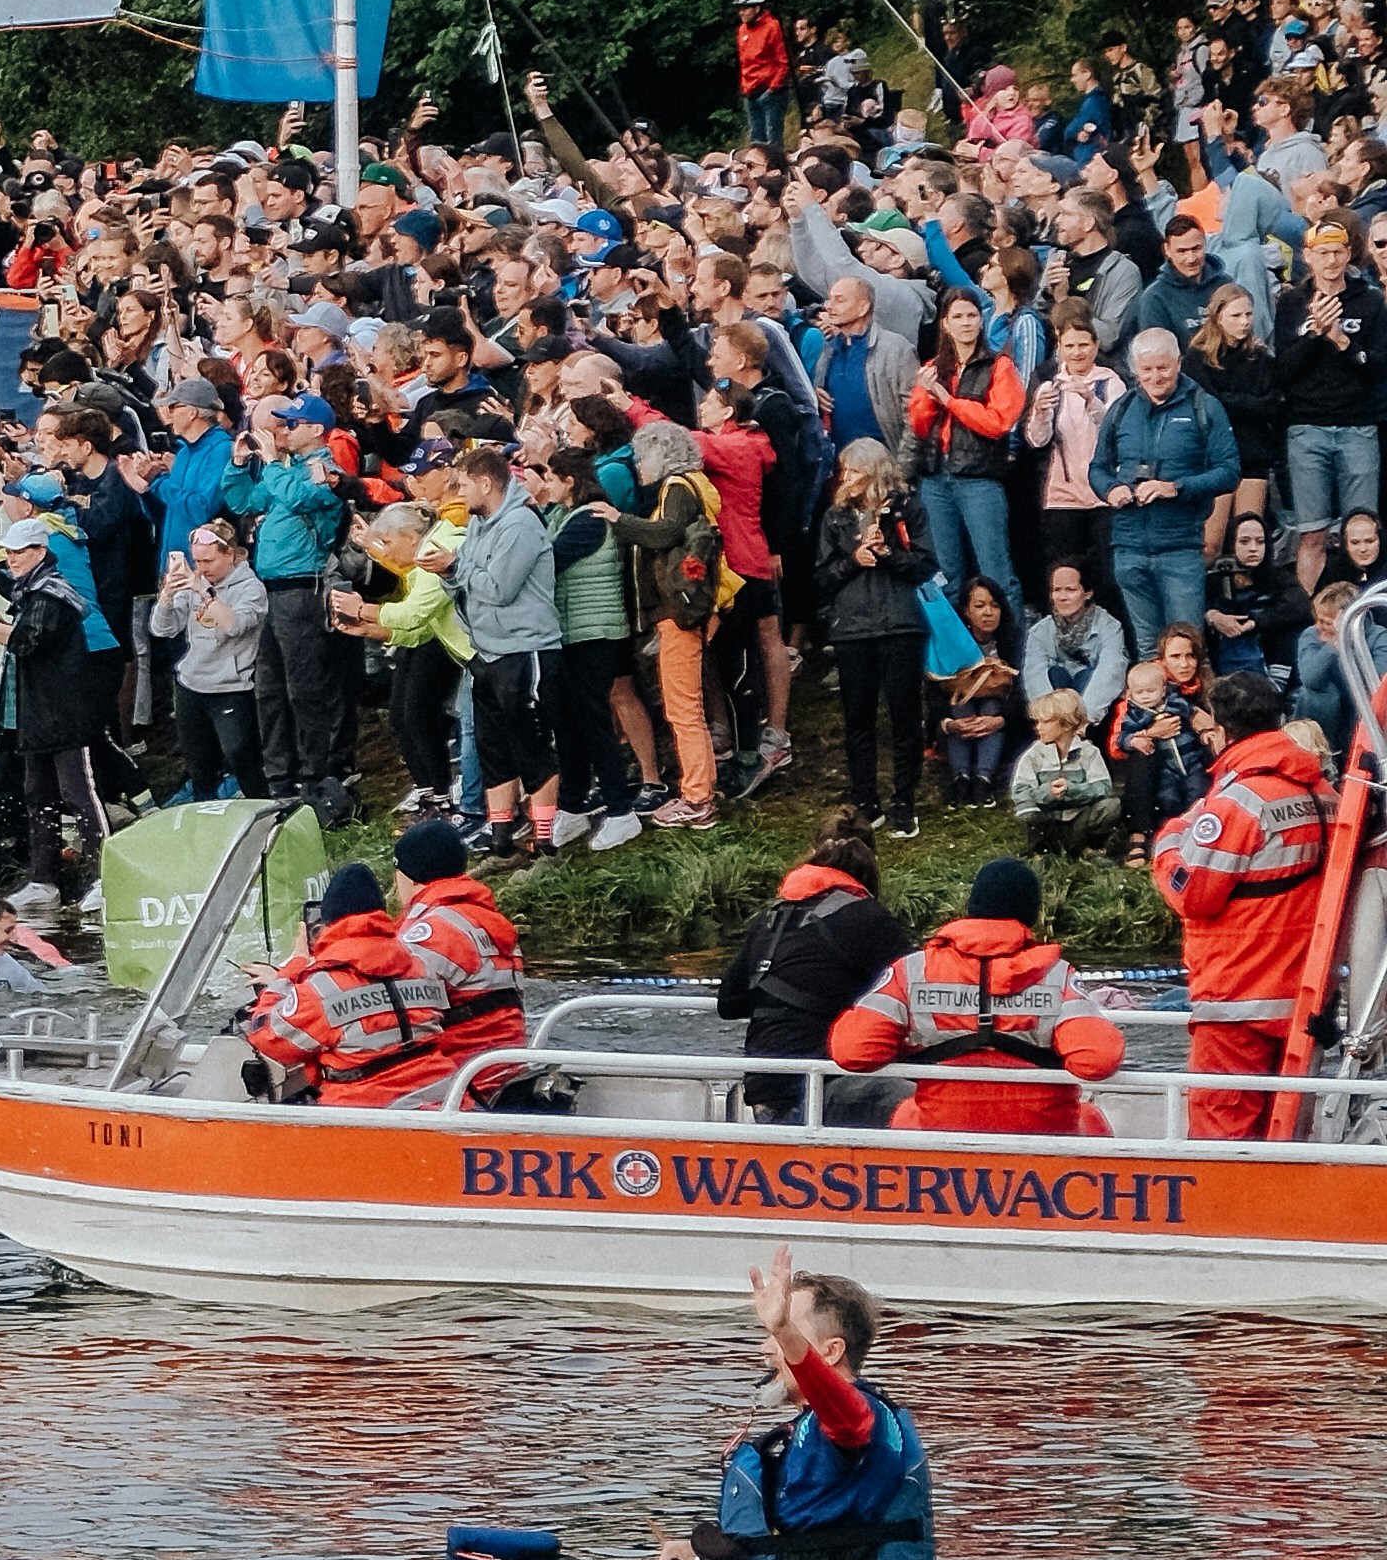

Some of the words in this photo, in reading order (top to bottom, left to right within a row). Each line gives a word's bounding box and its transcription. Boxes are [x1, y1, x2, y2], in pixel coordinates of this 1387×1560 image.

[140, 890, 260, 928] DATV
[332, 986, 442, 1017] WASSEWACHT
[88, 1121, 143, 1148] TONI
[461, 1147, 607, 1200] BRK
[673, 1155, 1197, 1224] WASSERWACHT
